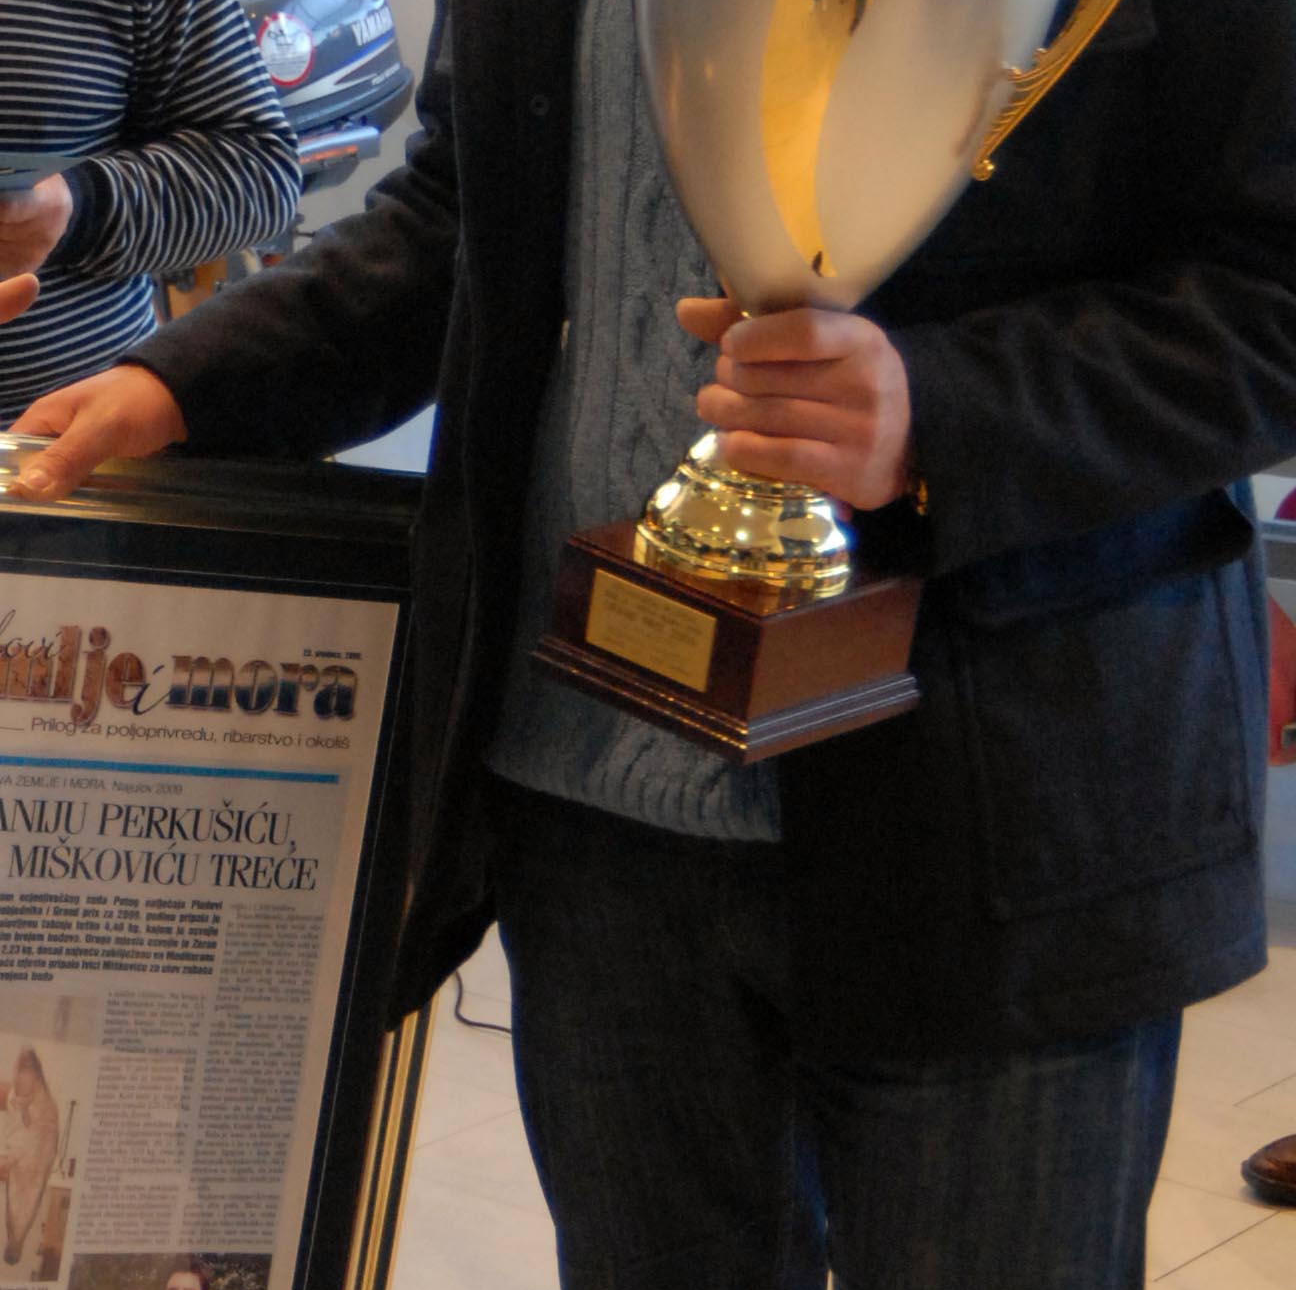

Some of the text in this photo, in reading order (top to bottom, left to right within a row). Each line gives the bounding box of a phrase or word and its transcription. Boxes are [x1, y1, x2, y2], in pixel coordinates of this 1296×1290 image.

[165, 654, 359, 721] mora
[31, 716, 76, 736] Prilog
[81, 723, 102, 734] za
[106, 722, 217, 742] poljoprivredu,
[223, 728, 294, 747] ribarstvo
[305, 734, 351, 750] okoliš
[96, 798, 297, 852] PERKUŠIĆU,
[8, 835, 202, 887] MIŠKOVIĆU
[210, 850, 318, 891] TREĆE
